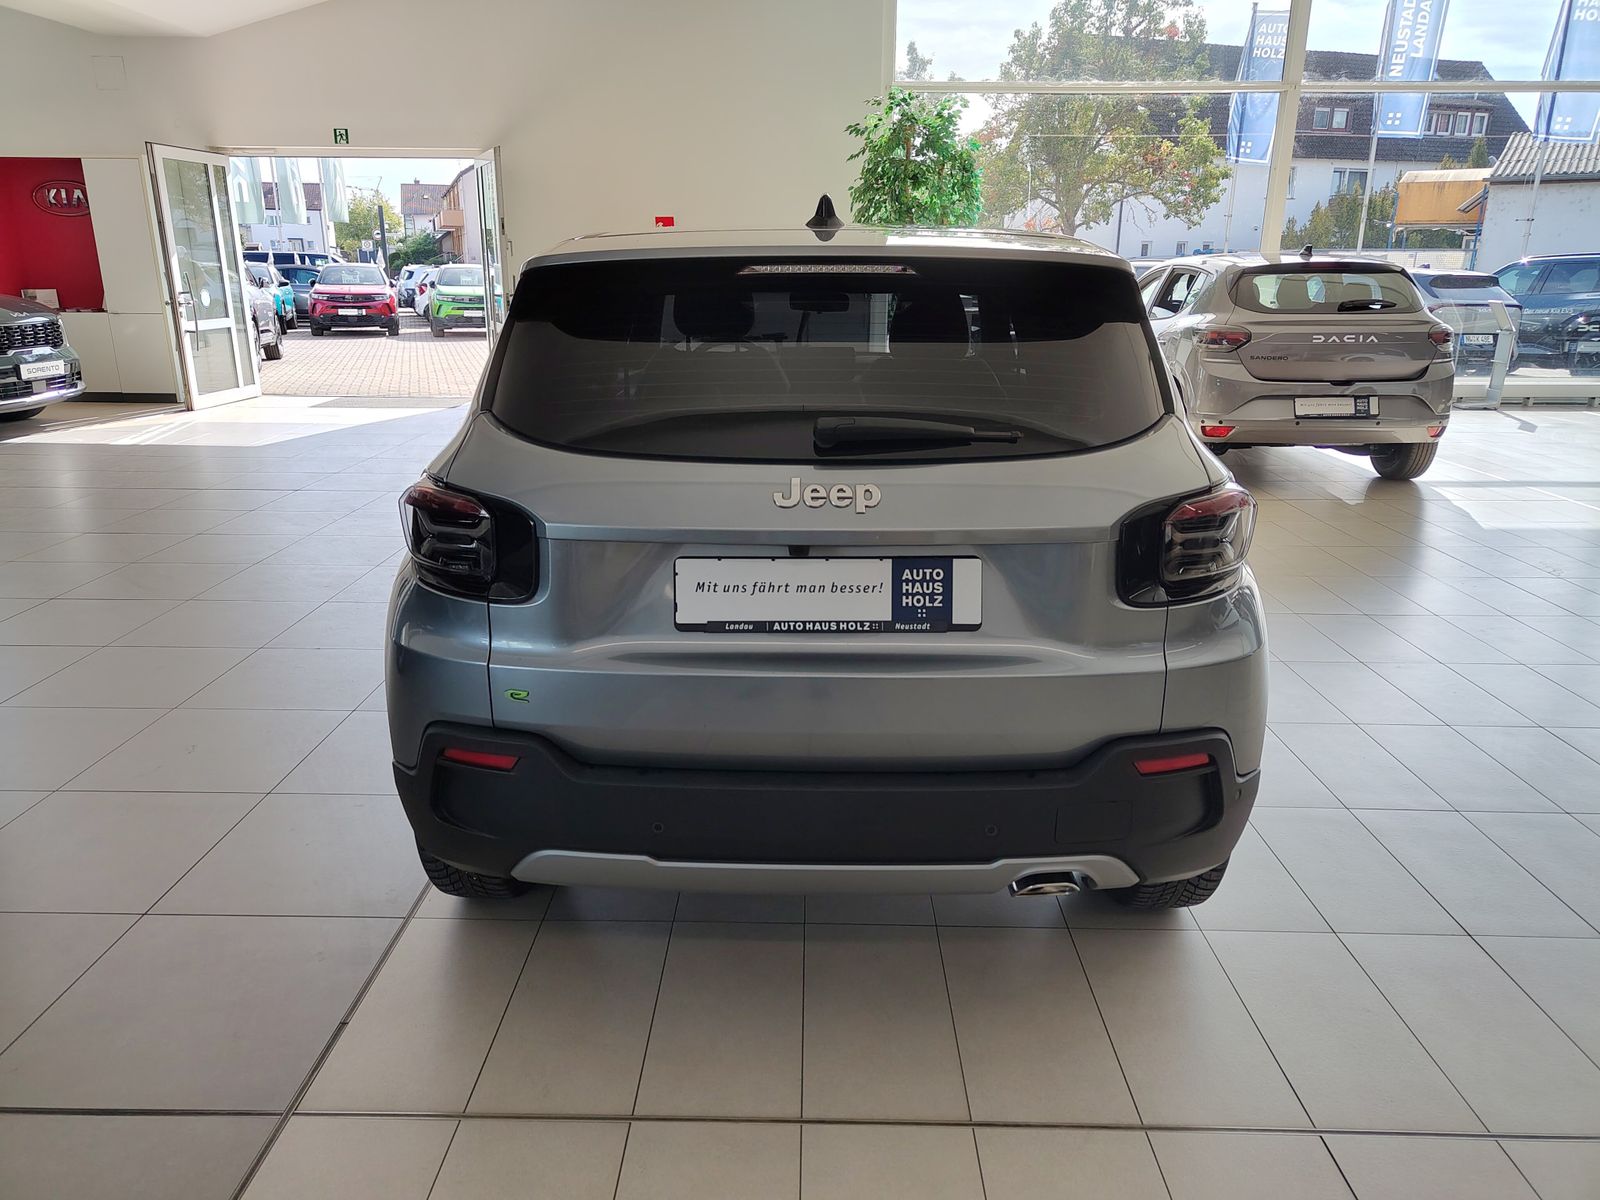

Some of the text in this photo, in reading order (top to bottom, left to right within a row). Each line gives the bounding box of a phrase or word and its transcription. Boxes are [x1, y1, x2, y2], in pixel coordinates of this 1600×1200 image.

[1573, 8, 1600, 21] HO
[1252, 47, 1285, 58] HOLZ
[45, 188, 89, 208] KIA
[1312, 334, 1378, 343] DACIA
[27, 364, 60, 375] SORENTO
[773, 477, 881, 514] Jeep
[902, 569, 944, 580] AUTO
[695, 581, 884, 596] Mit uns fährt man besser!
[902, 582, 943, 593] HAUS
[902, 595, 943, 607] HOLZ
[725, 622, 931, 630] Landau AUTO HAUS HOLZ Neustadt
